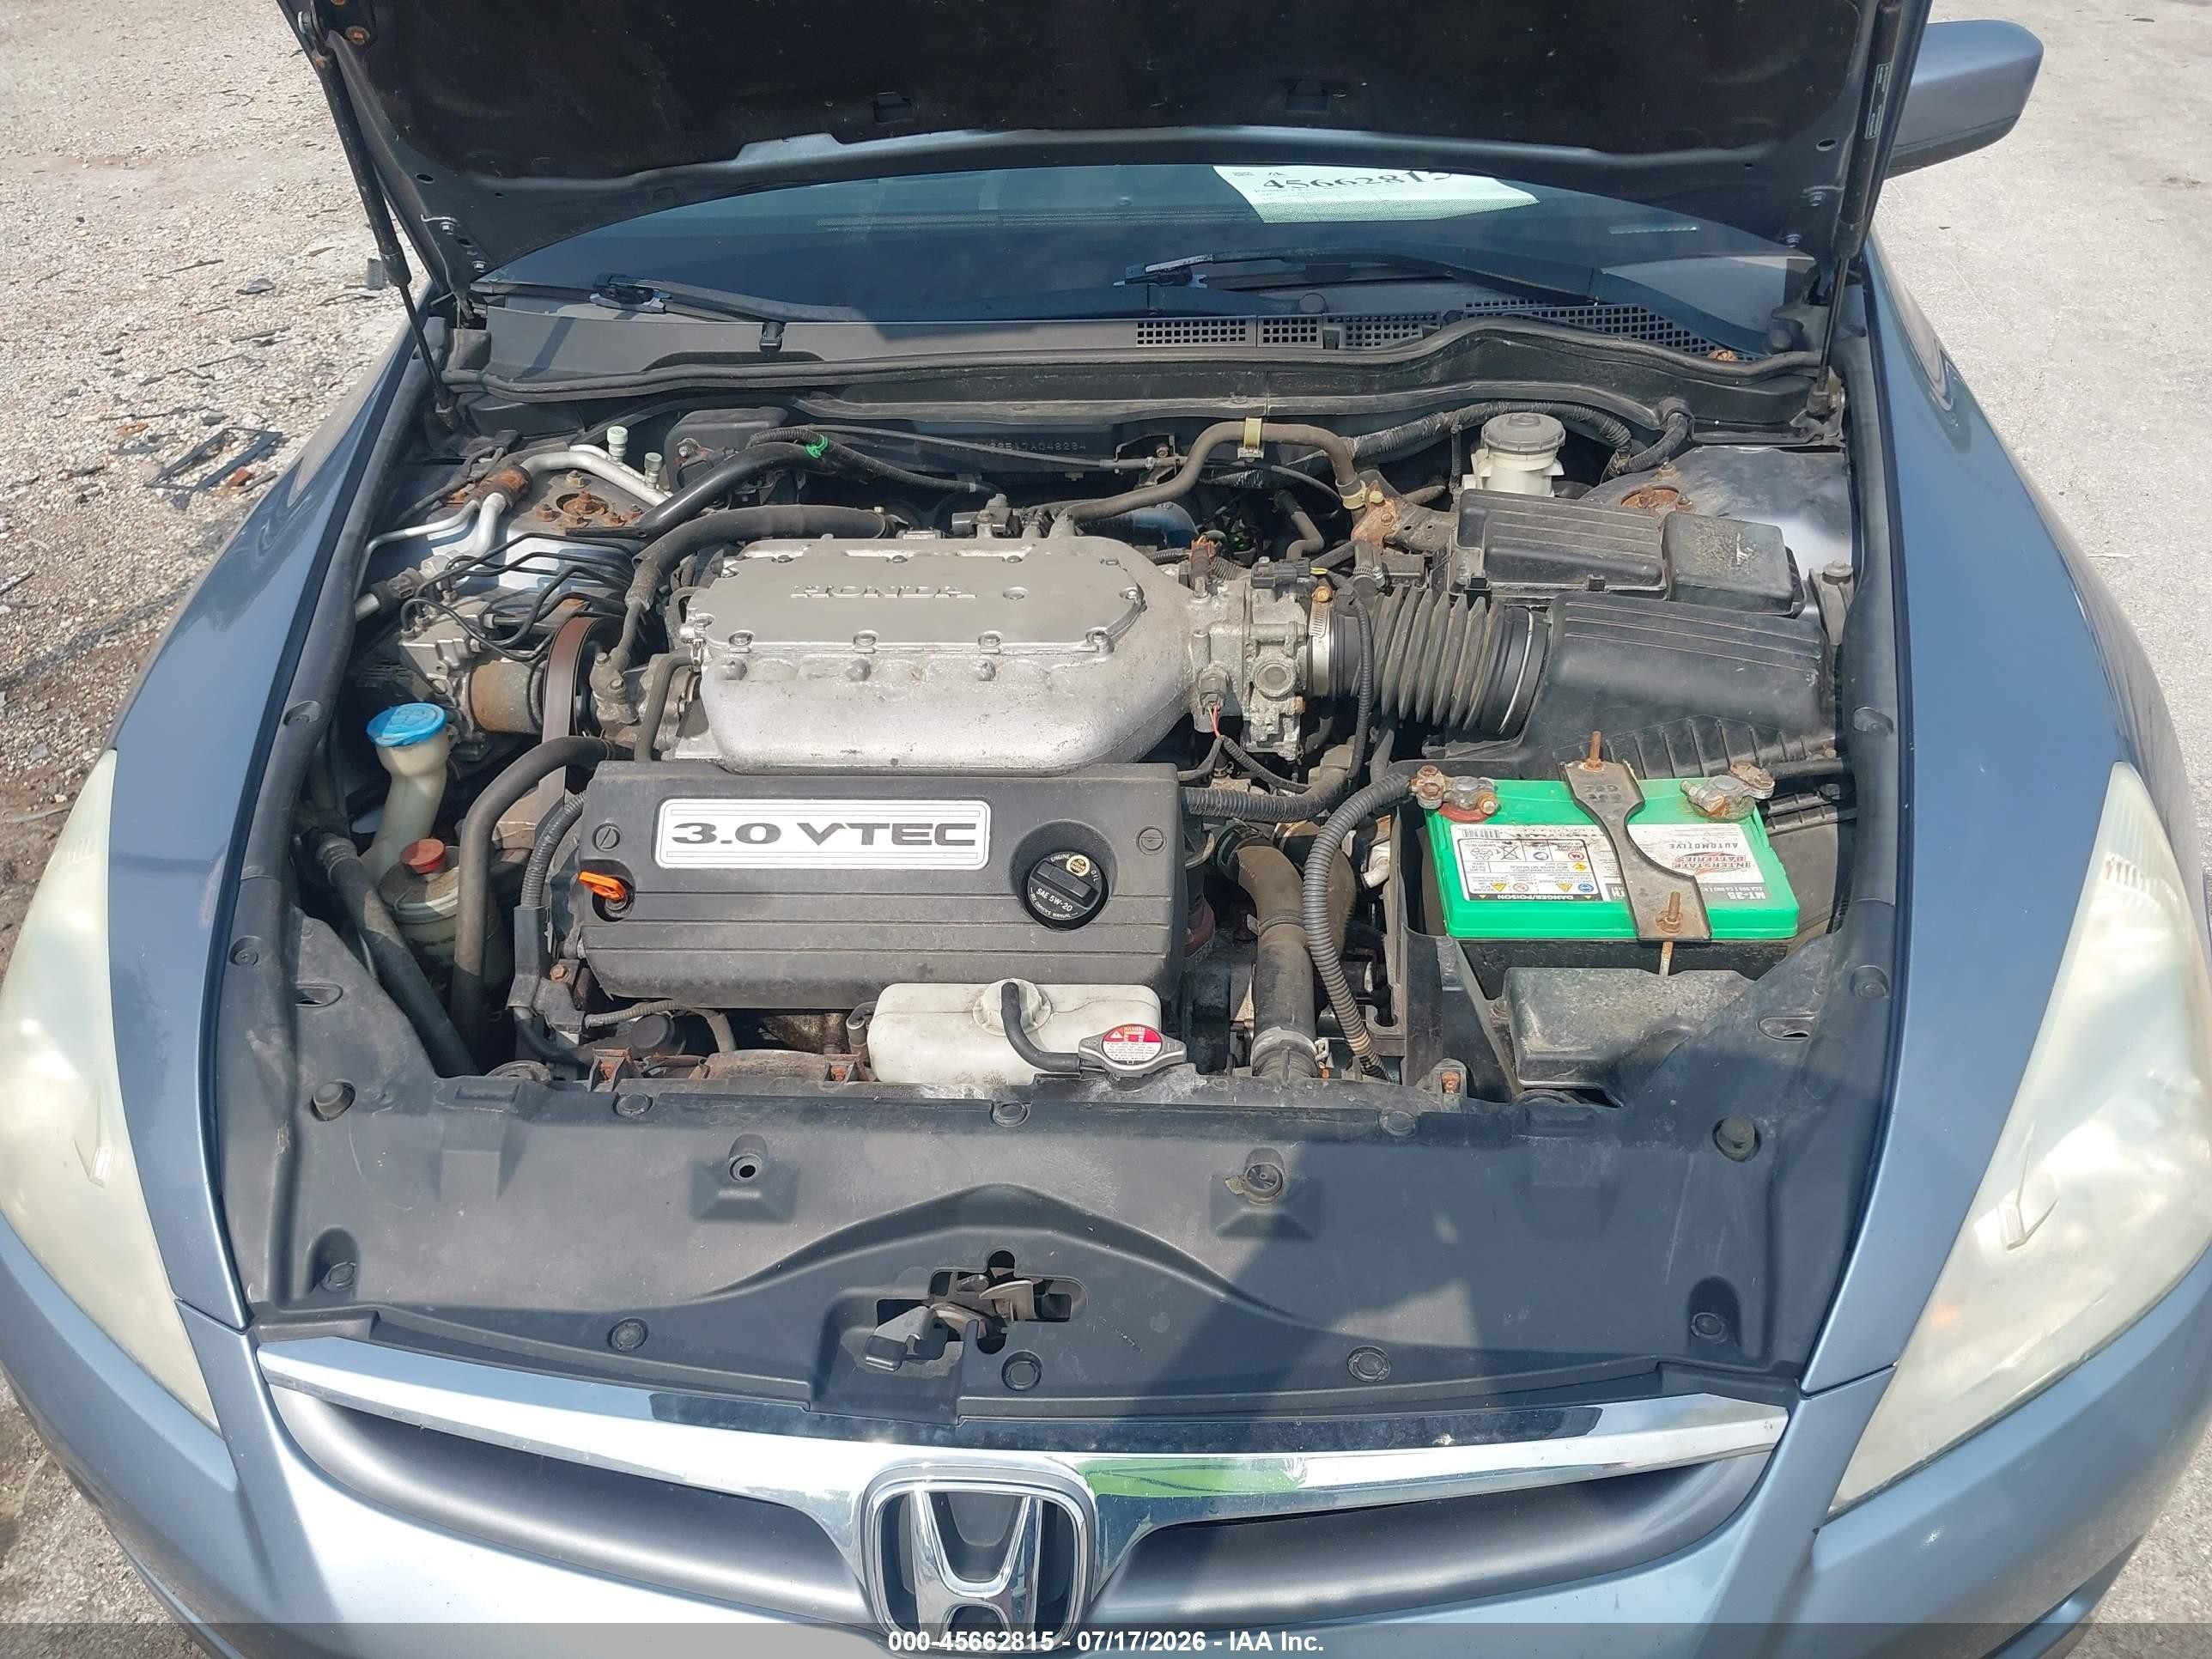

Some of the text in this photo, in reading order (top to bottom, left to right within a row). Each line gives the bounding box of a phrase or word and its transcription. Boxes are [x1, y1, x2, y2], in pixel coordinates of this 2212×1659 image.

[789, 585, 977, 599] HONDA
[672, 822, 977, 847] 3.0 VTEC
[1049, 854, 1099, 883] ENGINE OIL
[1036, 888, 1073, 913] SAE 5W-20
[1727, 890, 1767, 900] MT-35
